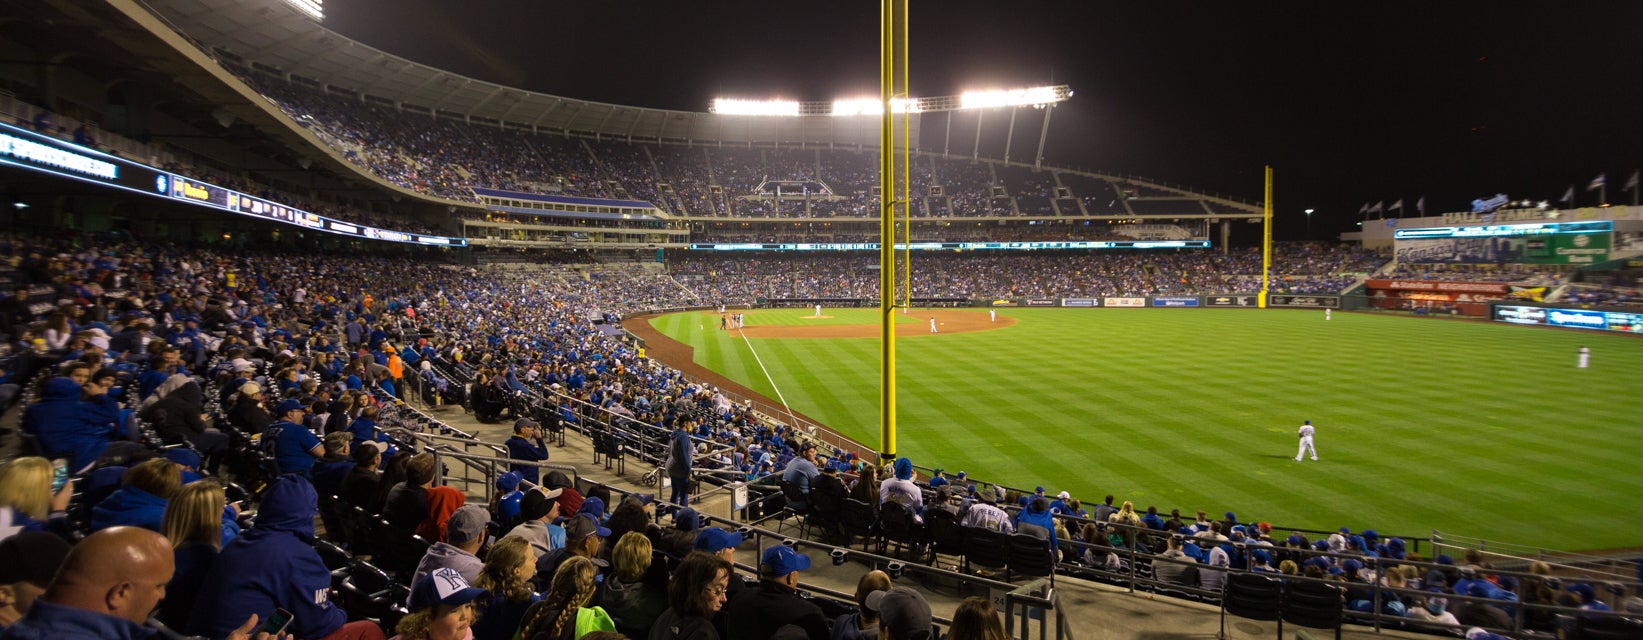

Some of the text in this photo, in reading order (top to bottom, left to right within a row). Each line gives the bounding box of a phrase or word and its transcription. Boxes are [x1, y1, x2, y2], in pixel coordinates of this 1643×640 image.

[1442, 211, 1481, 223] HALL
[1496, 208, 1543, 221] FAME
[1397, 244, 1455, 263] Kansas
[980, 508, 1001, 518] PEREZ
[994, 596, 1005, 605] 24
